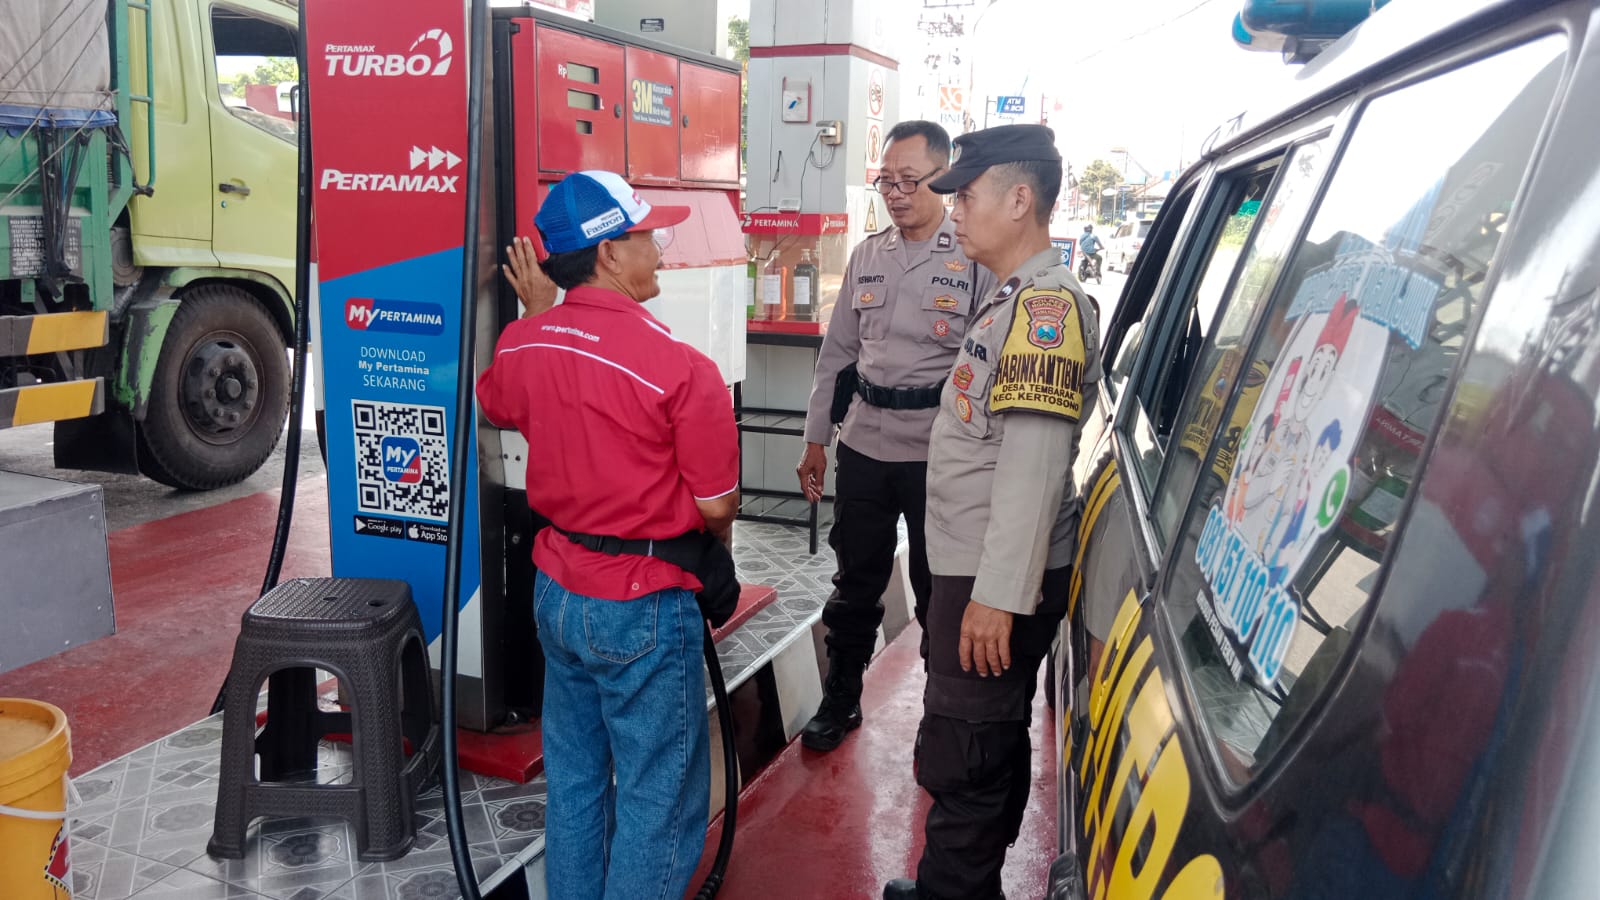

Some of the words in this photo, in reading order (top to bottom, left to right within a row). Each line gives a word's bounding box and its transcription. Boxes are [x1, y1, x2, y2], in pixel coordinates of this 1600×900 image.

[325, 44, 375, 53] PERTAMAX
[325, 54, 432, 77] TURBO
[558, 63, 567, 78] Rp
[600, 98, 605, 110] L
[632, 80, 653, 114] 3M
[940, 113, 960, 123] BNI
[320, 168, 459, 193] PERTAMAX
[586, 215, 623, 236] Fastron
[754, 218, 799, 228] PERTAMINA
[931, 276, 969, 291] POLRI
[349, 304, 381, 327] My
[380, 310, 442, 325] PERTAMINA
[361, 346, 426, 362] DOWNLOAD
[358, 360, 373, 372] My
[376, 361, 430, 375] Pertamina
[363, 374, 426, 391] SEKARANG
[1003, 384, 1025, 393] DESA
[1029, 384, 1075, 400] TEMBARAK
[993, 392, 1016, 403] KEC.
[1018, 392, 1079, 412] KERTOSONO
[386, 445, 416, 467] My
[367, 523, 389, 533] Google
[421, 531, 436, 541] App
[437, 532, 448, 542] Sto
[1195, 504, 1228, 583] 081
[1212, 532, 1246, 605] 151
[1230, 558, 1268, 639] 110
[1250, 589, 1297, 682] 110
